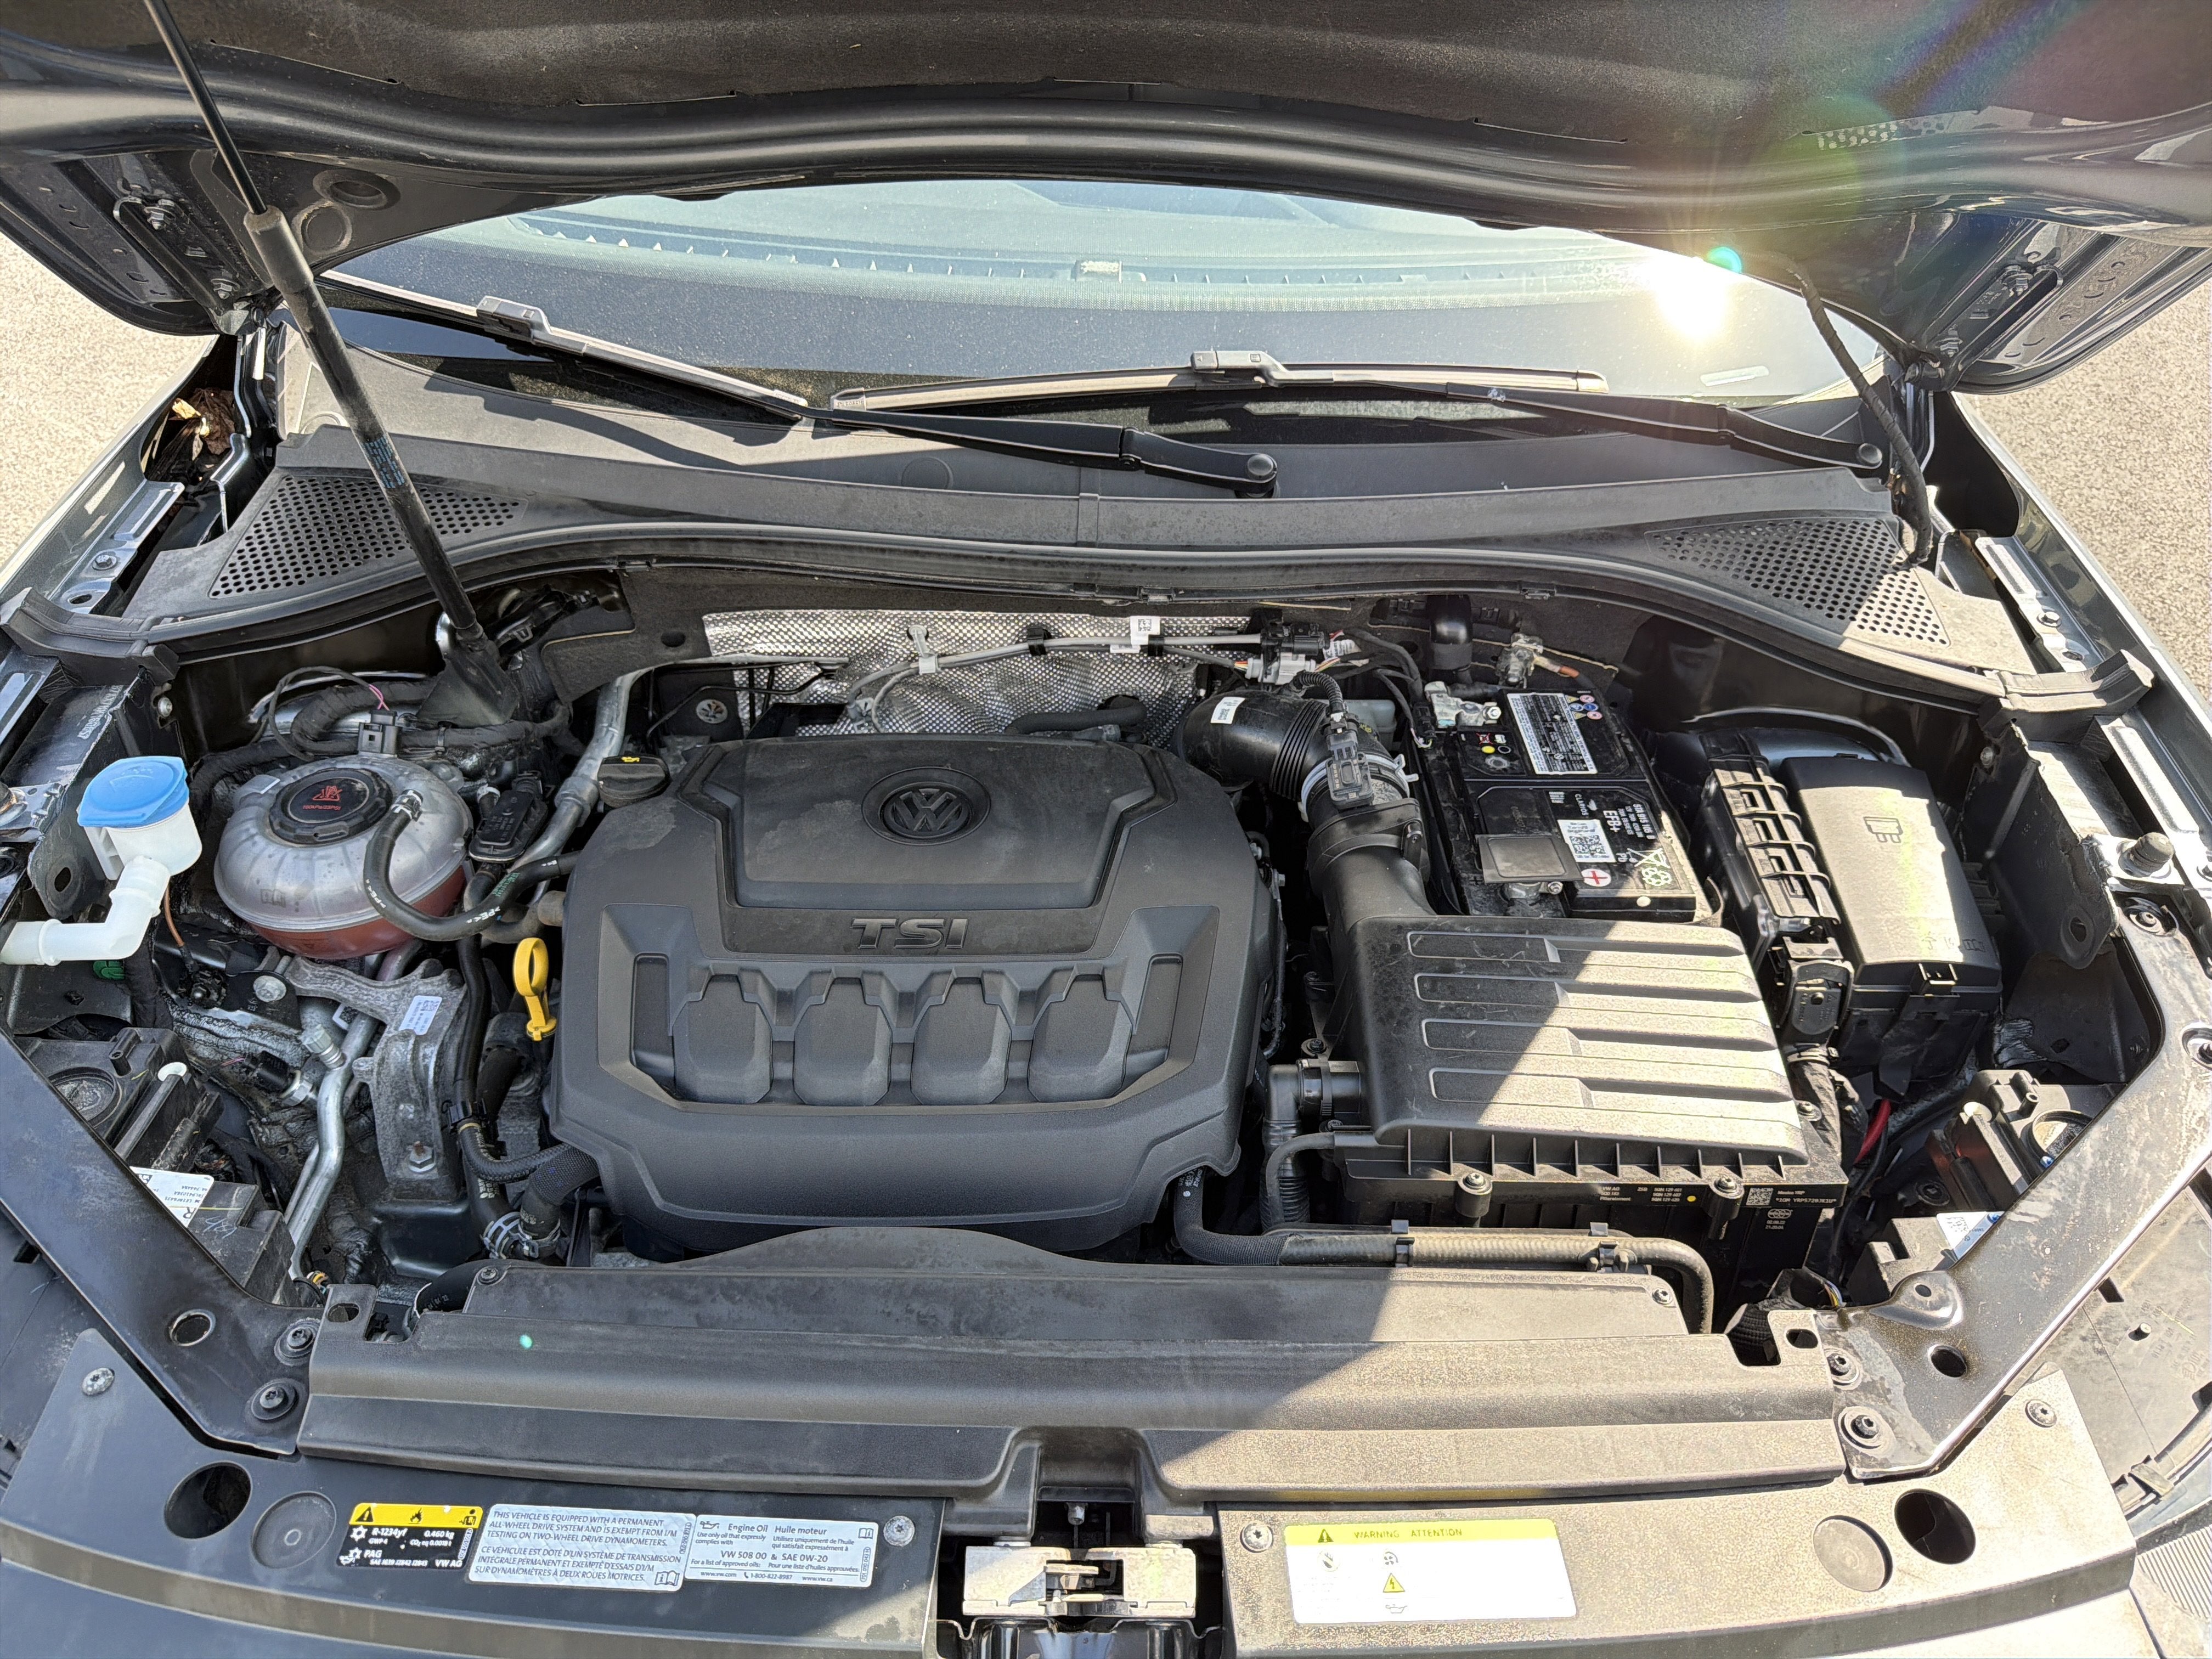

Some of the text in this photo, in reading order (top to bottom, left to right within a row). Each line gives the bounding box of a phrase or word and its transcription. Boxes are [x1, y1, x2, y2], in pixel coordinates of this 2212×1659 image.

[1575, 793, 1589, 815] CLARIOS
[1603, 810, 1622, 832] EFB+
[1637, 814, 1649, 823] 915
[1616, 853, 1628, 862] Pb
[851, 918, 969, 950] TSI
[617, 1518, 664, 1526] PERMANENT
[371, 1527, 408, 1538] R-1234yf
[445, 1531, 455, 1539] kg
[727, 1525, 755, 1534] Engine
[1353, 1527, 1463, 1539] WARNING ATTENTION
[531, 1533, 580, 1542] TWO-WHEEL
[603, 1537, 669, 1546] DYNAMOMETERS.
[364, 1549, 382, 1559] PAG
[626, 1554, 682, 1562] TRANSMISSION
[435, 1559, 448, 1567] VW
[516, 1559, 562, 1567] PERMANENT
[607, 1572, 646, 1581] MOTRICES.
